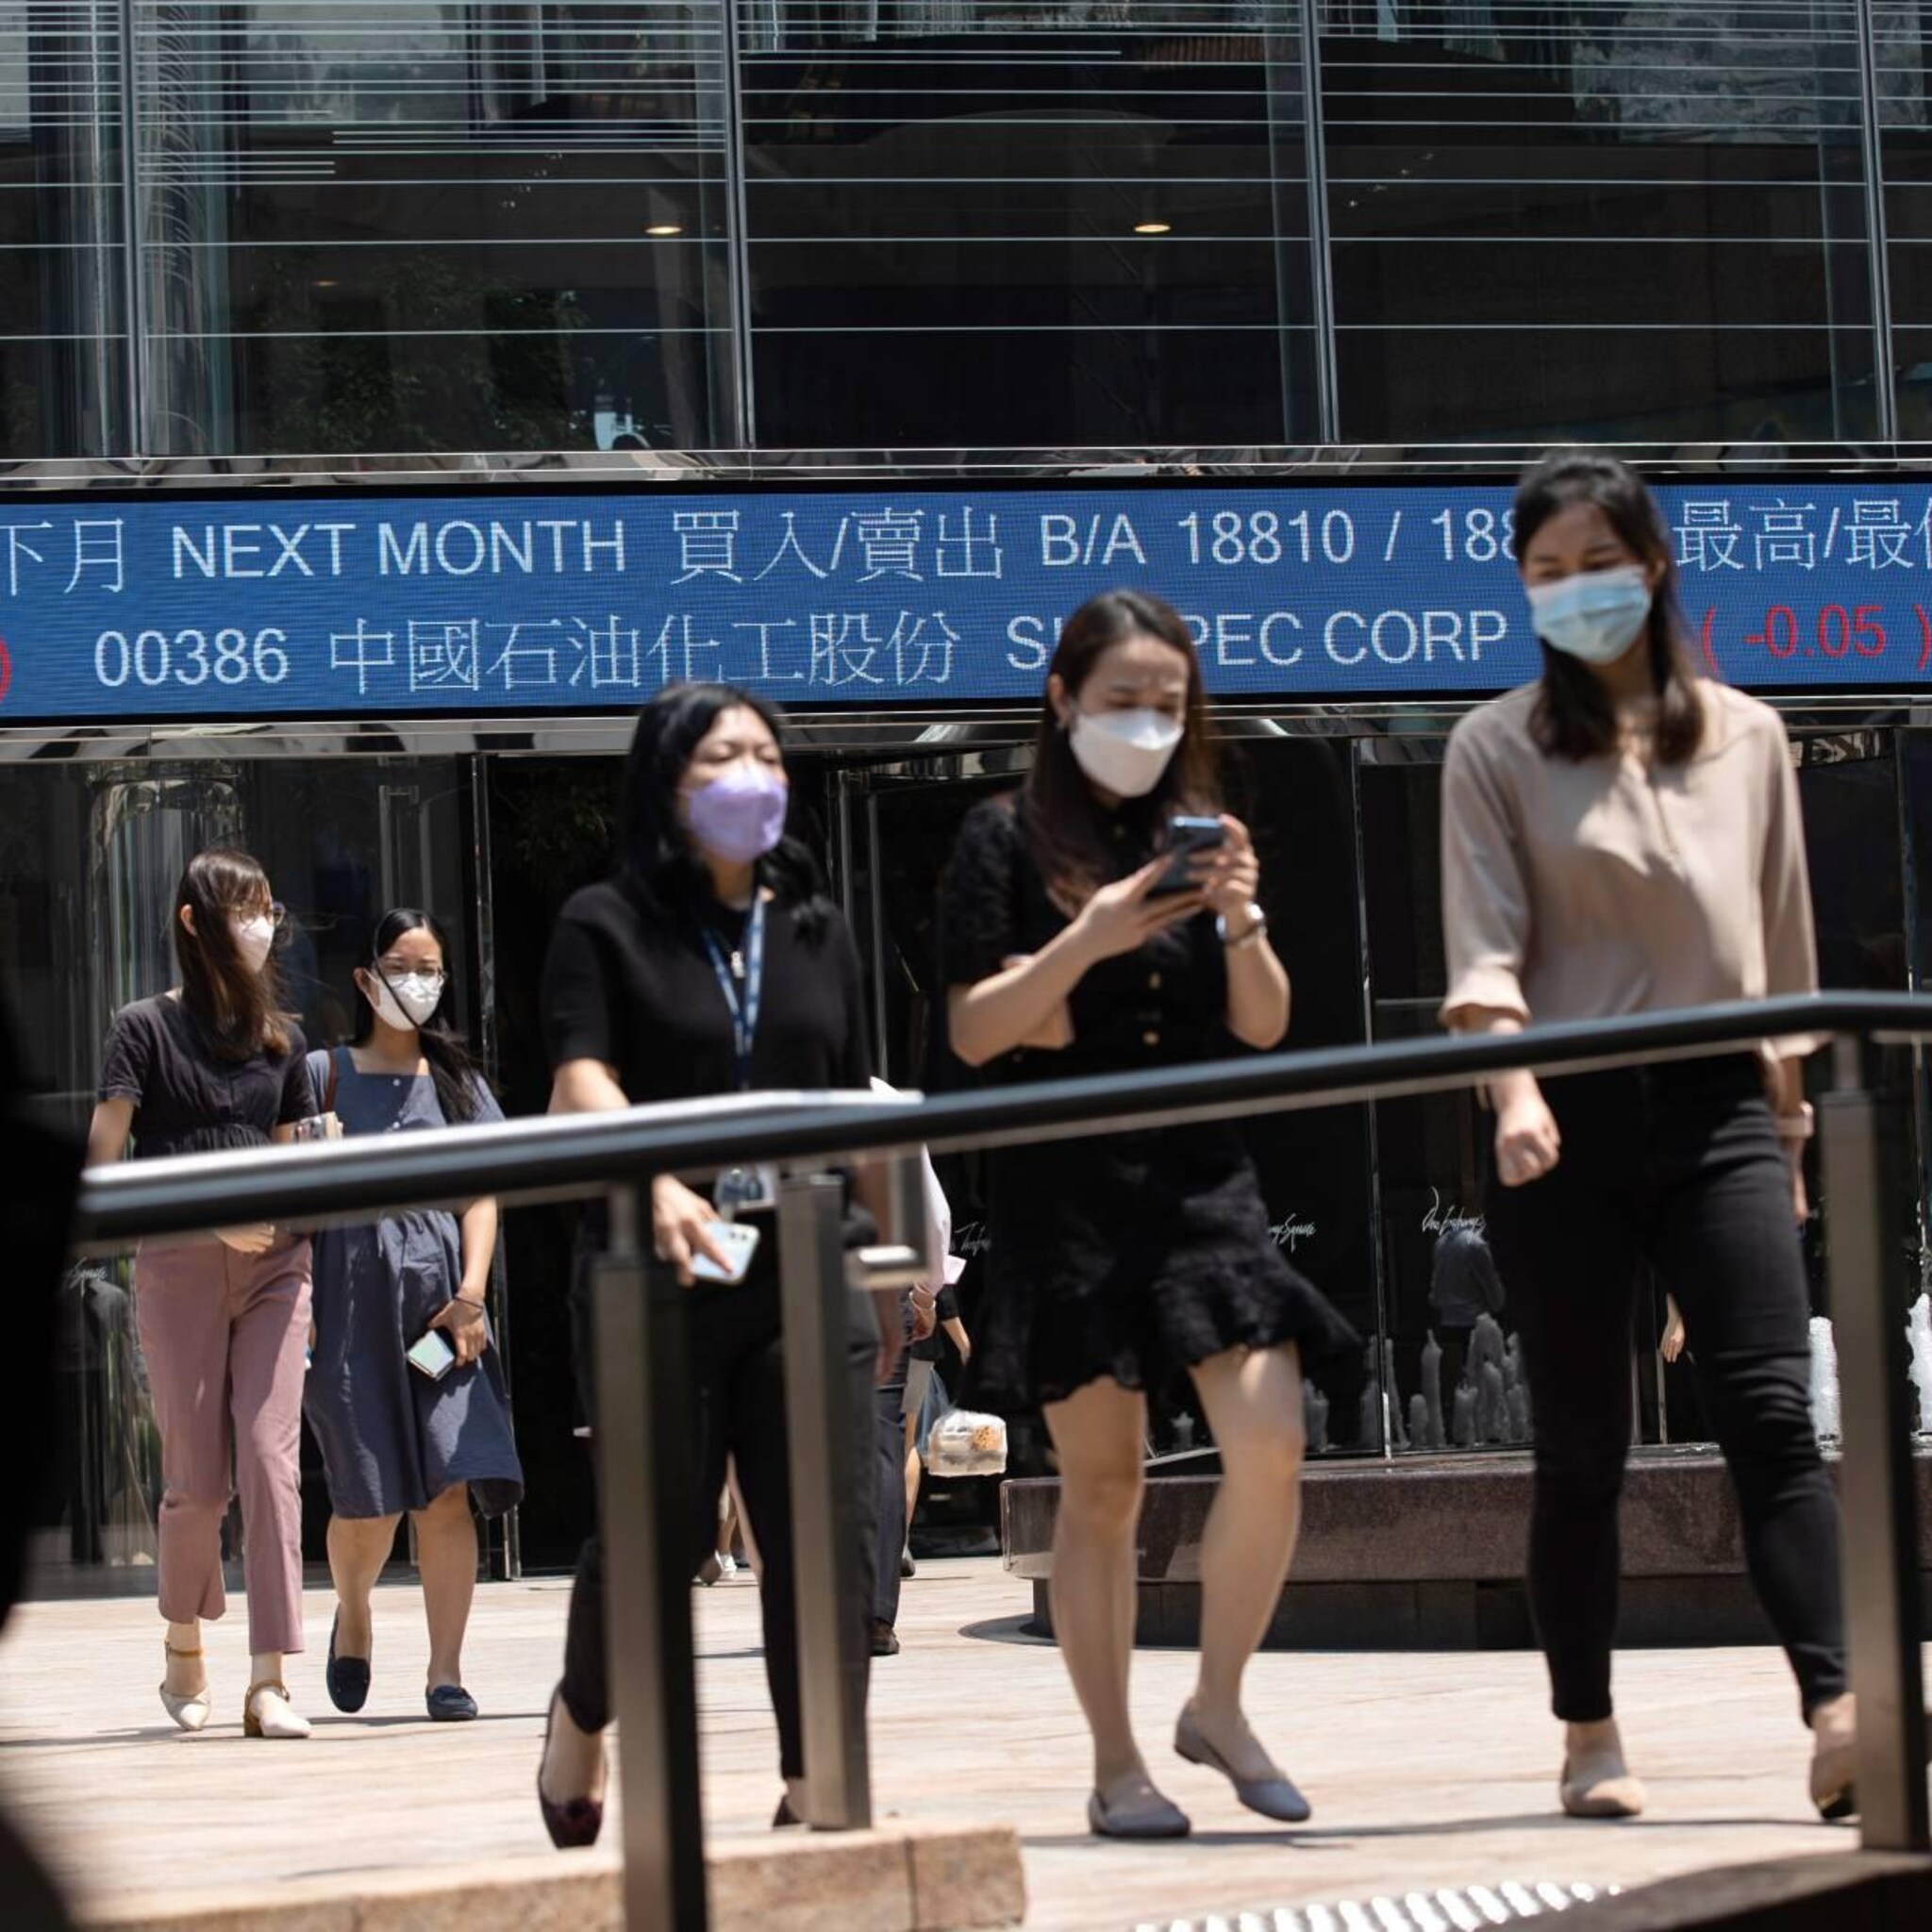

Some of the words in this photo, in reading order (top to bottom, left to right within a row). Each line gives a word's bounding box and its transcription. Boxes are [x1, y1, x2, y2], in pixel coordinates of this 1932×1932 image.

[0, 518, 124, 596] 下月
[173, 524, 356, 578] NEXT
[378, 520, 625, 575] MONTH
[671, 507, 1003, 584] 買入/賣出
[1041, 514, 1145, 566] B/A
[1178, 510, 1354, 564] 18810
[94, 627, 290, 687] 00386
[330, 611, 959, 693] 中國石油化工股份
[1007, 612, 1303, 670] SIPEC
[1324, 611, 1507, 664] CORP
